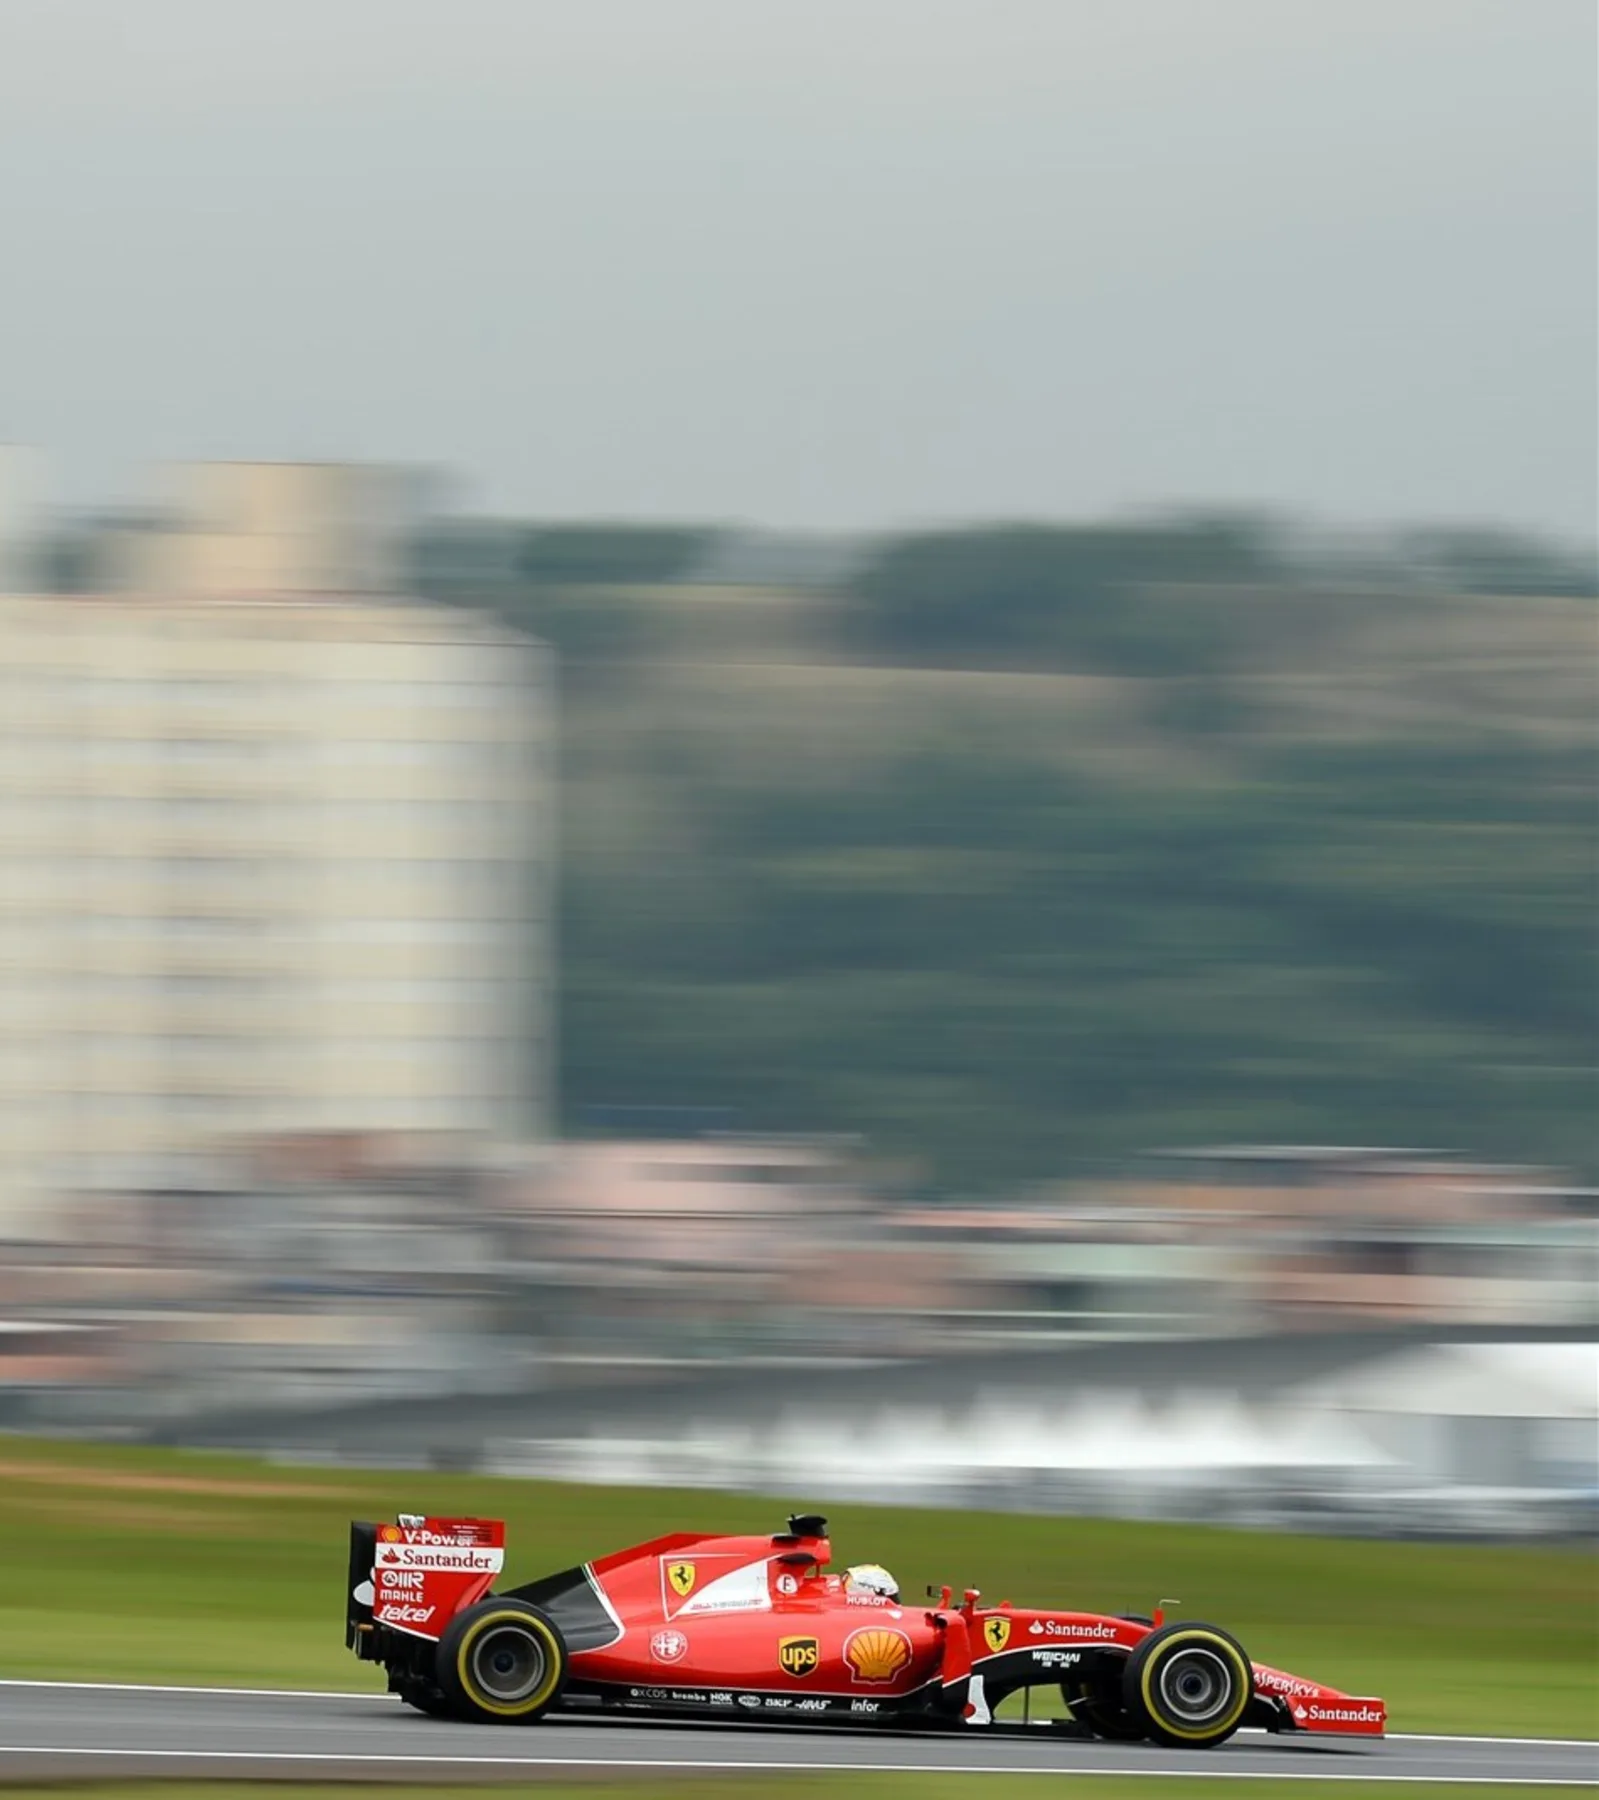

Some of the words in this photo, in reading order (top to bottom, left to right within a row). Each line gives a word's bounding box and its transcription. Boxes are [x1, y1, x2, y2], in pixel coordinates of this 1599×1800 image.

[403, 1549, 491, 1568] Santander
[380, 1589, 424, 1602] MAHLE
[846, 1596, 886, 1606] HUBLOT
[379, 1604, 436, 1622] telcel
[1045, 1620, 1117, 1638] Santander
[1032, 1651, 1081, 1662] WEICHAI
[1253, 1672, 1312, 1697] ASPERSKY
[672, 1691, 706, 1701] brembo
[851, 1699, 879, 1712] infor
[1309, 1705, 1382, 1722] Santander
